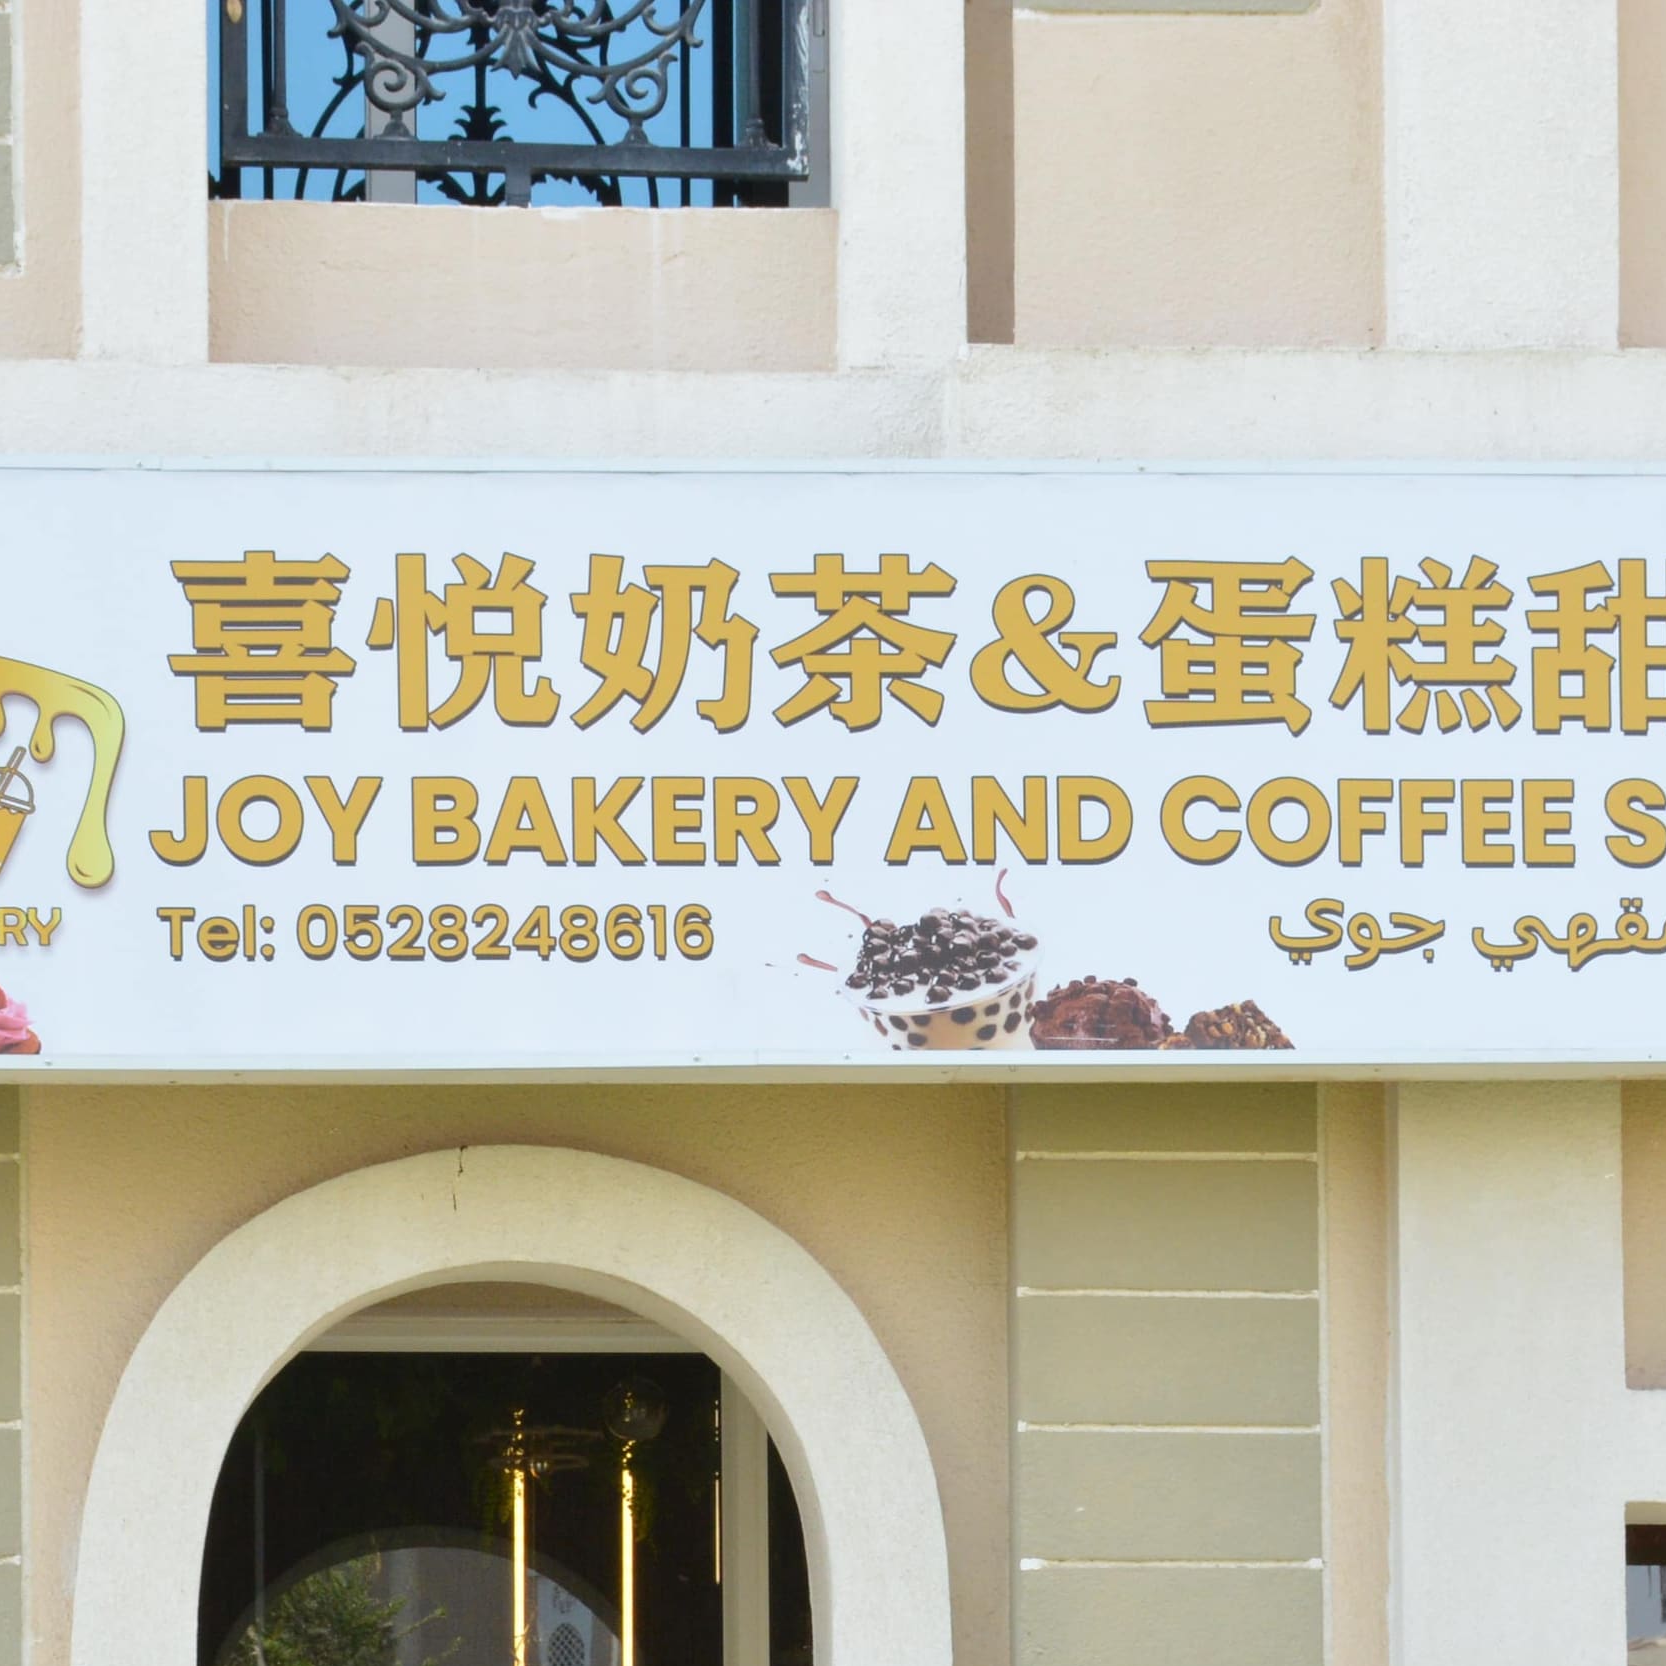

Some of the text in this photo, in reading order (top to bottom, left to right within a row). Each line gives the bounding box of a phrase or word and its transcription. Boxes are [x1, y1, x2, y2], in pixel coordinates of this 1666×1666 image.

[148, 775, 383, 868] JOY
[412, 776, 860, 868] BAKERY
[884, 776, 1133, 867] AND
[1160, 776, 1576, 869] COFFEE
[156, 904, 715, 963] Tel: 0528248616
